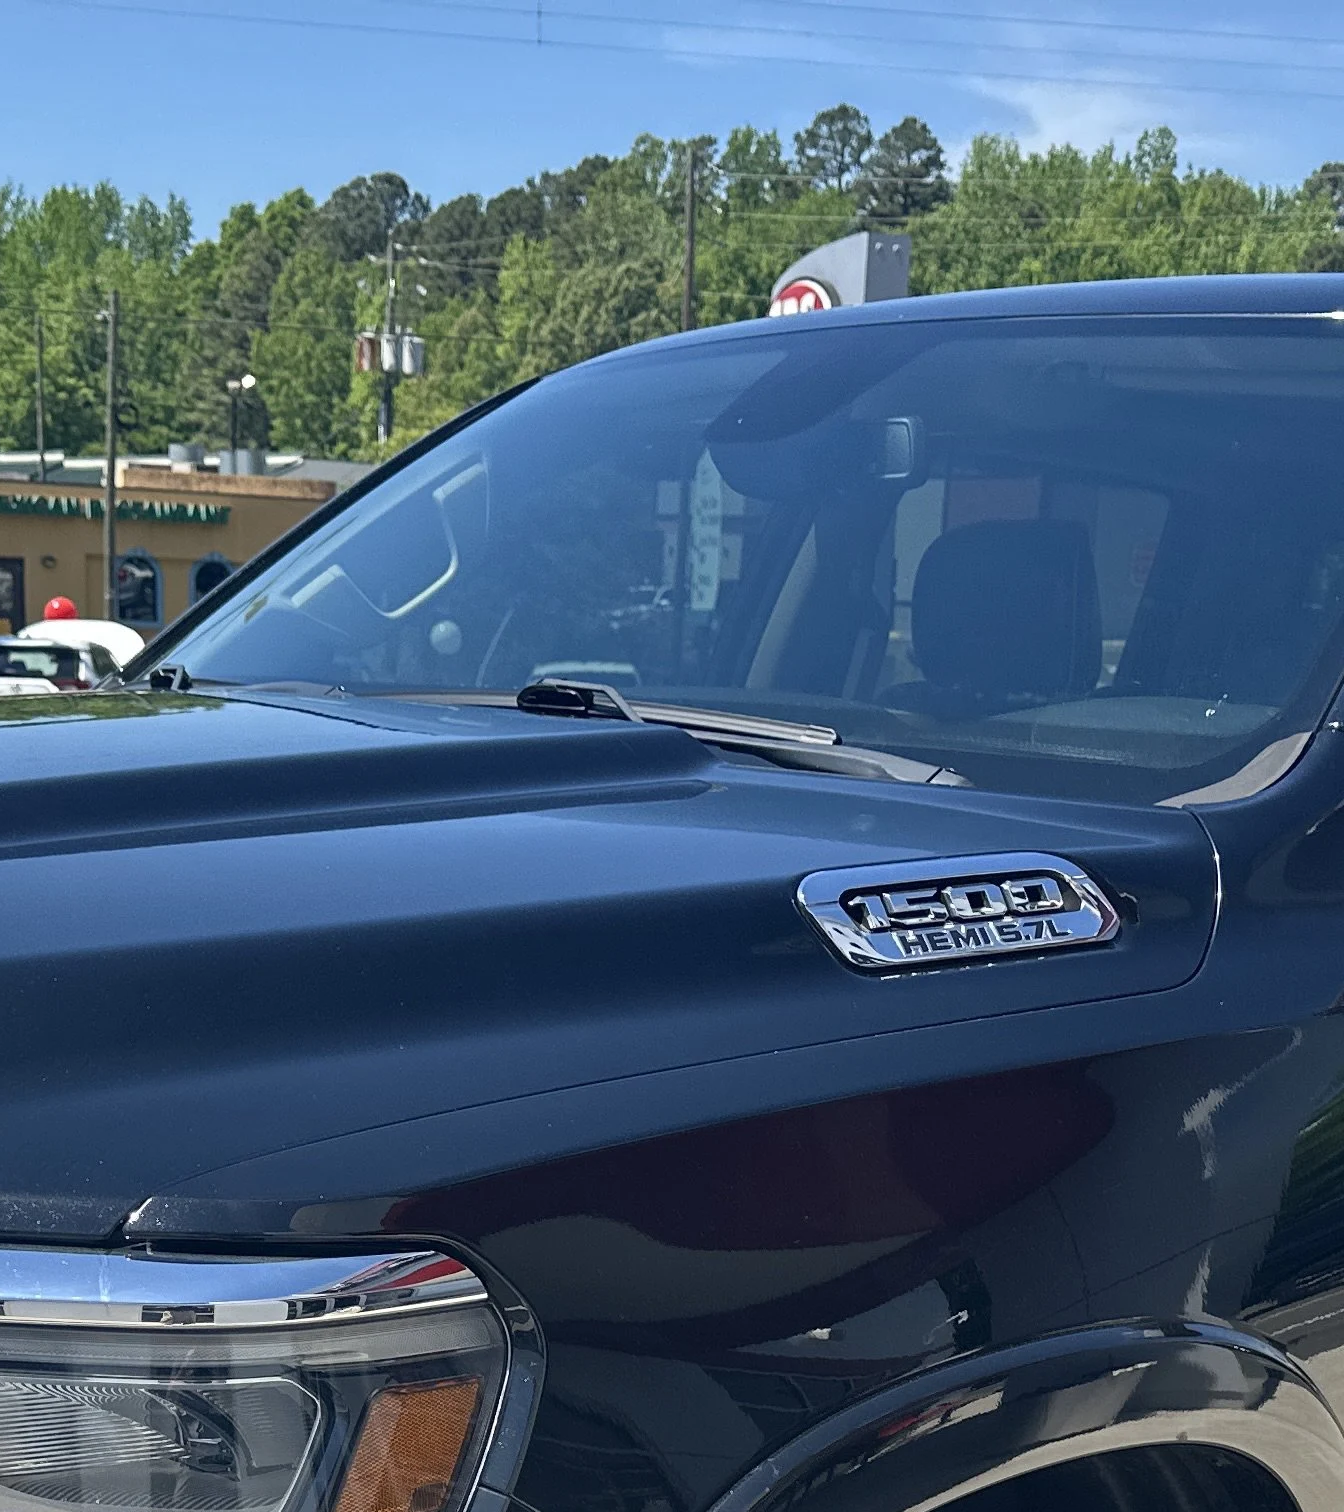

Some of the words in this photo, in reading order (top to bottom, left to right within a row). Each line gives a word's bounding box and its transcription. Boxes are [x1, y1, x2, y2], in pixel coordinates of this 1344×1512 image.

[845, 875, 1065, 932] 1500
[899, 925, 990, 959] HEMI
[995, 919, 1073, 948] 5.7L
